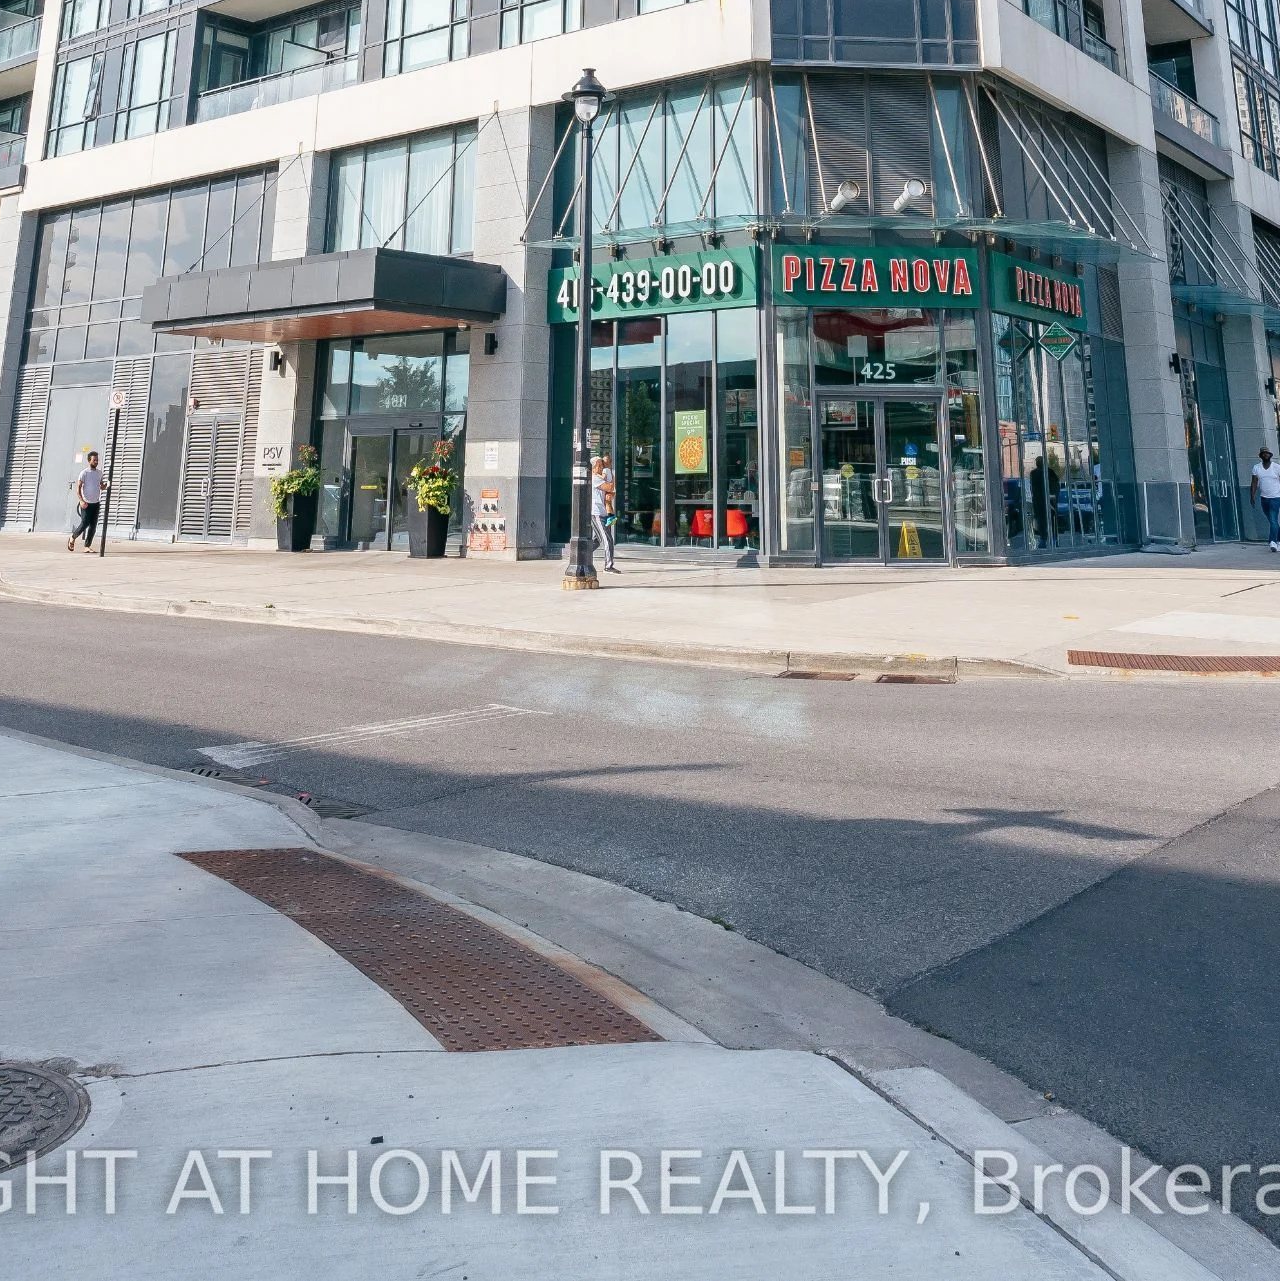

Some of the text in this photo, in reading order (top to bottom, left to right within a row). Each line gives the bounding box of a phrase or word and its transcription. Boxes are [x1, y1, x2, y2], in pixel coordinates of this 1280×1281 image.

[557, 260, 734, 308] 41-439-00-00
[782, 255, 972, 295] PIZZA NOVA
[1015, 266, 1083, 318] PIZZA NOVA
[860, 362, 896, 380] 425
[263, 446, 283, 459] PSV
[900, 457, 917, 465] PUSH
